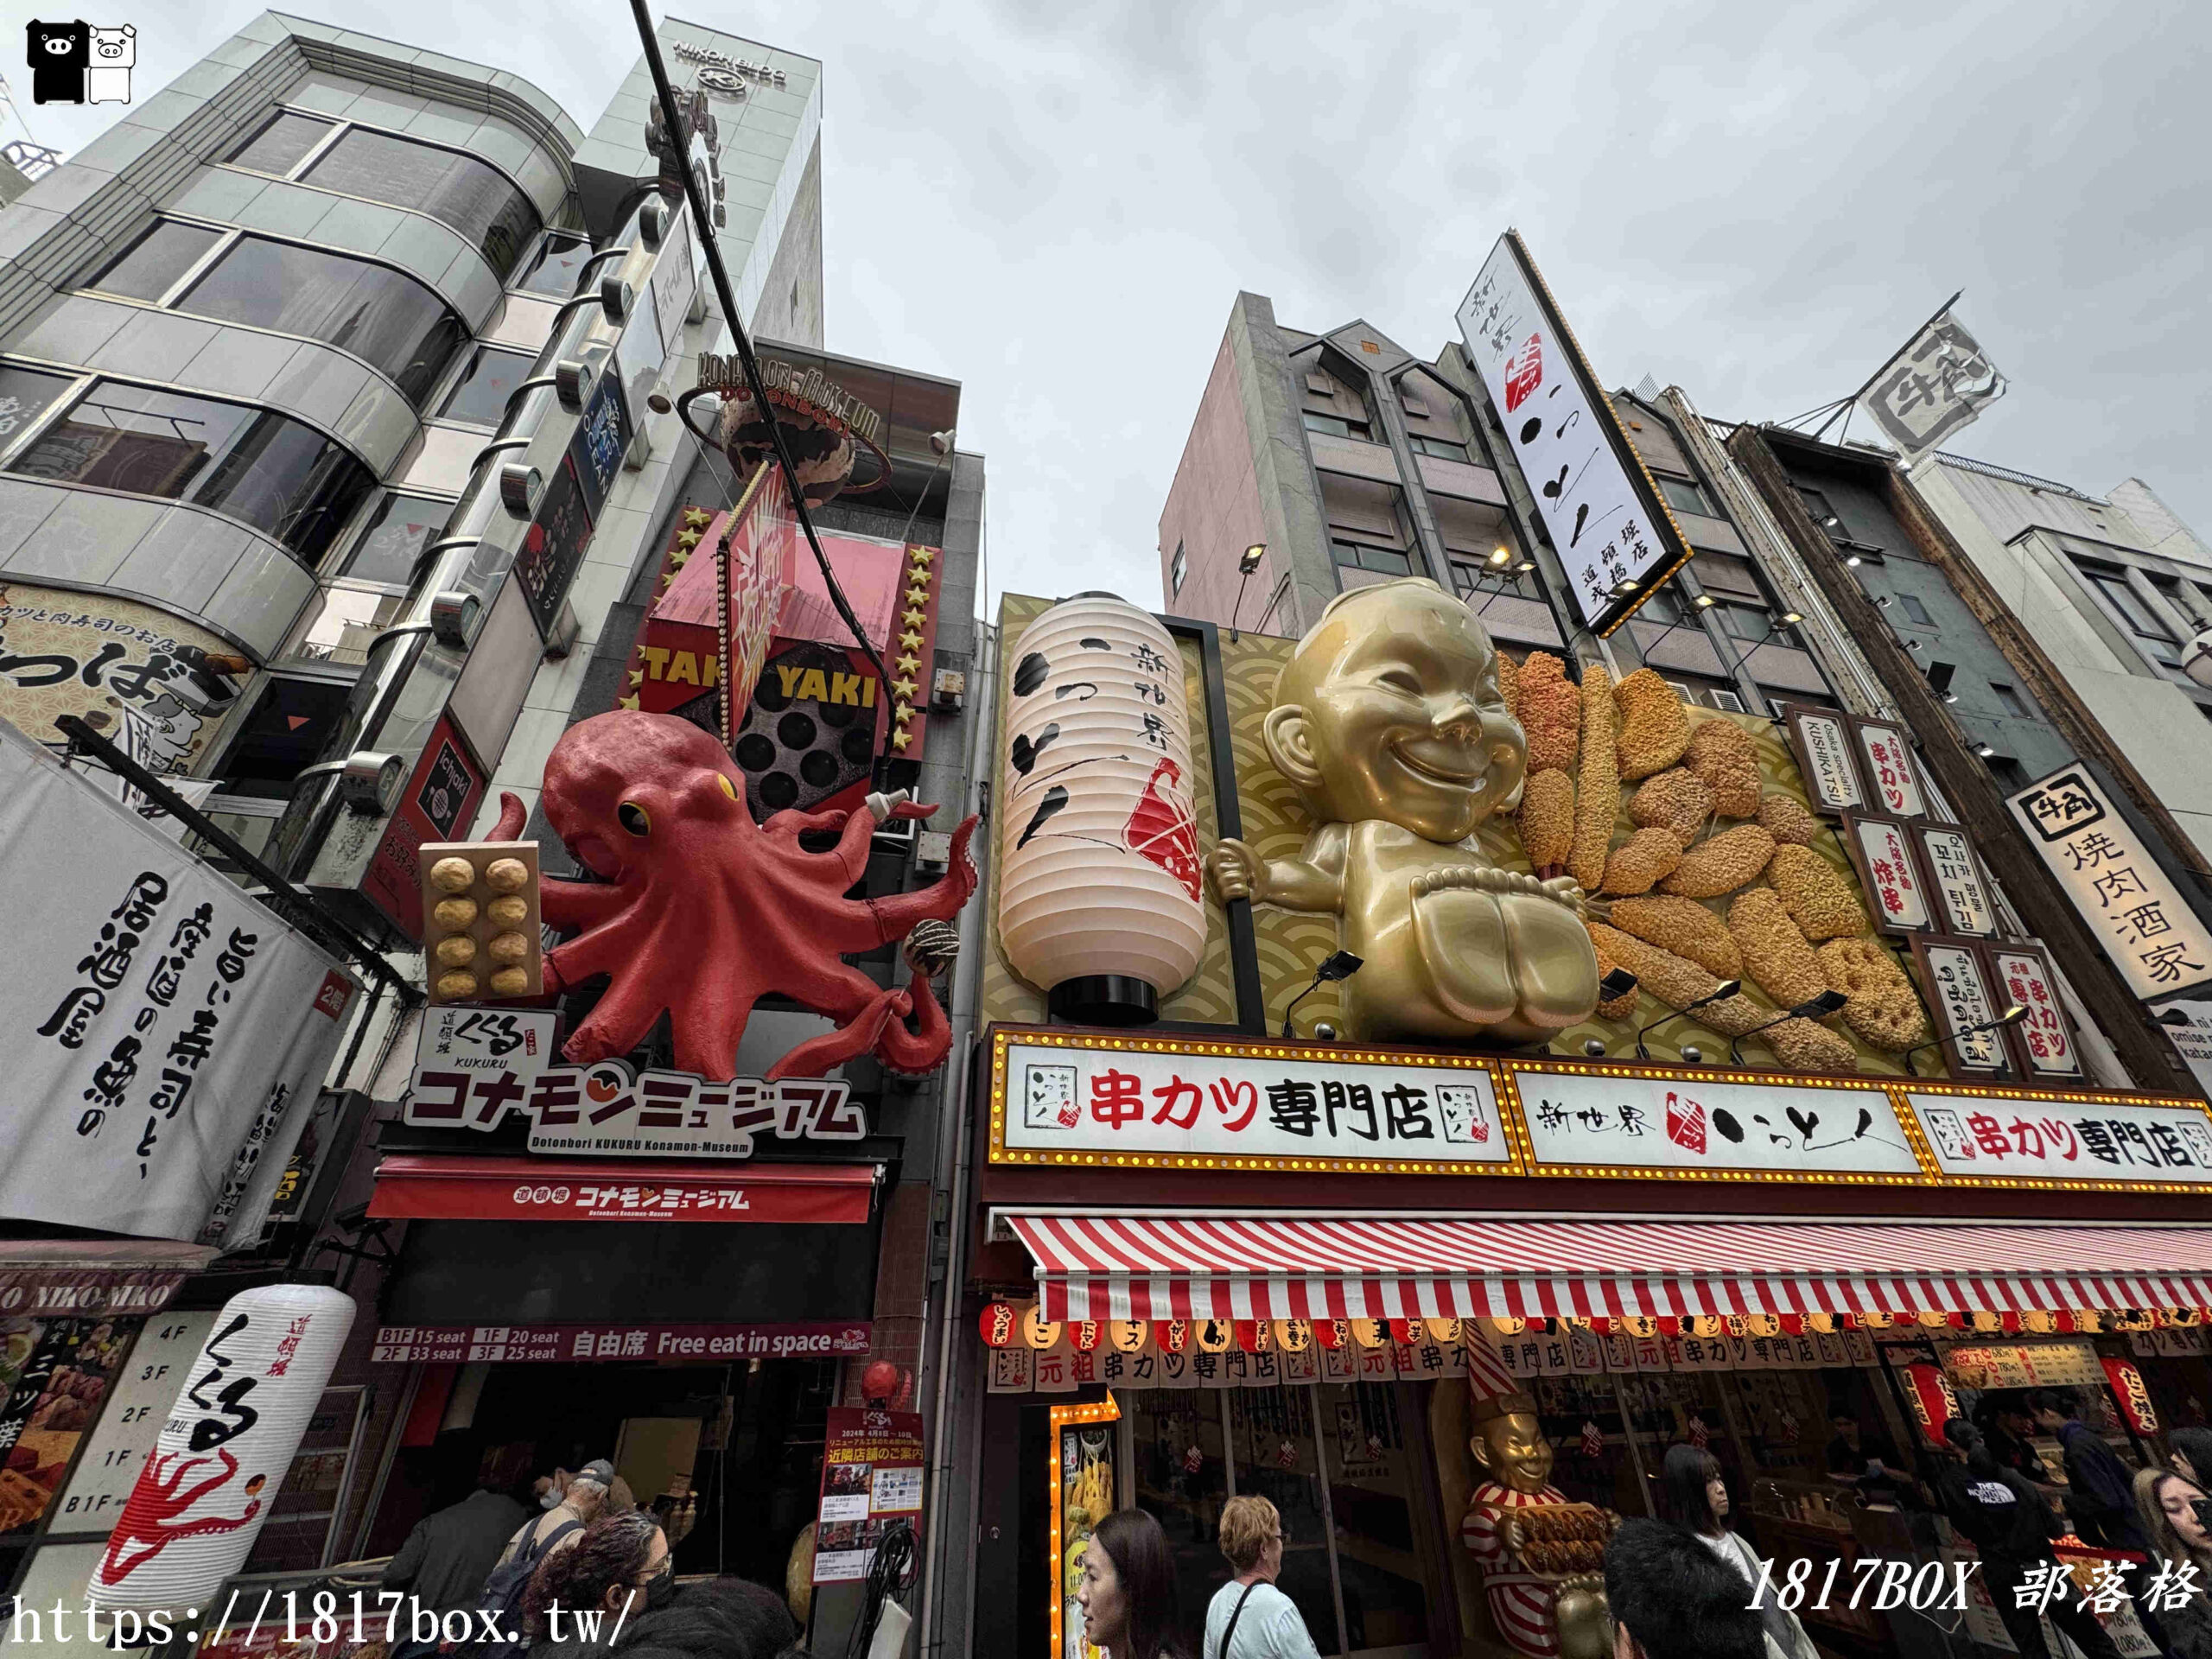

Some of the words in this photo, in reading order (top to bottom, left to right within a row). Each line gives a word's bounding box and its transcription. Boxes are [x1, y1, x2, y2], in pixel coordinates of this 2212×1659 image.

[721, 385, 850, 438] DOONBORI
[799, 367, 880, 440] MUSEUM
[583, 414, 608, 495] OCEAN
[1824, 723, 1839, 753] Osaka
[1833, 753, 1853, 798] specialty
[1870, 741, 1904, 809] 串カツ
[385, 834, 422, 891] お好み
[1949, 836, 1971, 876] 오사카
[1933, 844, 1959, 880] 꼬치
[1948, 889, 1974, 930] 튀김
[2063, 832, 2205, 983] 焼肉酒家
[36, 871, 168, 1050] 居酒屋
[435, 1009, 457, 1054] 道頓堀
[454, 1012, 524, 1057] くくる
[2028, 978, 2066, 1058] 串カツ
[2171, 1031, 2207, 1044] omise
[454, 1057, 509, 1070] KUKURU
[412, 1070, 860, 1134] コナモンミュージアム
[1090, 1069, 1435, 1141] 串カツ専門店
[1536, 1099, 1656, 1136] 新世界
[531, 1135, 594, 1150] Dotonbori
[595, 1138, 641, 1151] KUKURU
[644, 1140, 749, 1154] Konamon-Museum
[1966, 1111, 2195, 1167] 串カツ専門店
[515, 1187, 569, 1203] 道頓堀
[575, 1186, 750, 1210] コナモンミュージアム
[160, 1325, 188, 1340] 4F
[381, 1328, 412, 1344] B1F
[417, 1331, 434, 1344] 15
[436, 1332, 467, 1344] seat
[483, 1329, 501, 1342] 1F
[510, 1331, 529, 1344] 20
[531, 1332, 560, 1344] seat
[572, 1330, 649, 1357] 自由席
[657, 1332, 706, 1354] Free
[709, 1334, 746, 1353] eat
[748, 1330, 767, 1352] in
[772, 1334, 831, 1357] space
[994, 1306, 1012, 1344] しゅうまい
[142, 1365, 169, 1381] 3F
[381, 1347, 401, 1360] 2F
[410, 1347, 429, 1360] 33
[432, 1348, 462, 1360] seat
[478, 1346, 498, 1360] 3F
[506, 1347, 525, 1360] 25
[527, 1347, 556, 1360] seat
[1039, 1351, 1275, 1382] 元祖串カツ専門店
[188, 1313, 258, 1452] くくる
[121, 1407, 150, 1423] 2F
[105, 1450, 131, 1466] 1F
[828, 1446, 925, 1465] 近隣店舗のご案内
[65, 1495, 111, 1513] B1F
